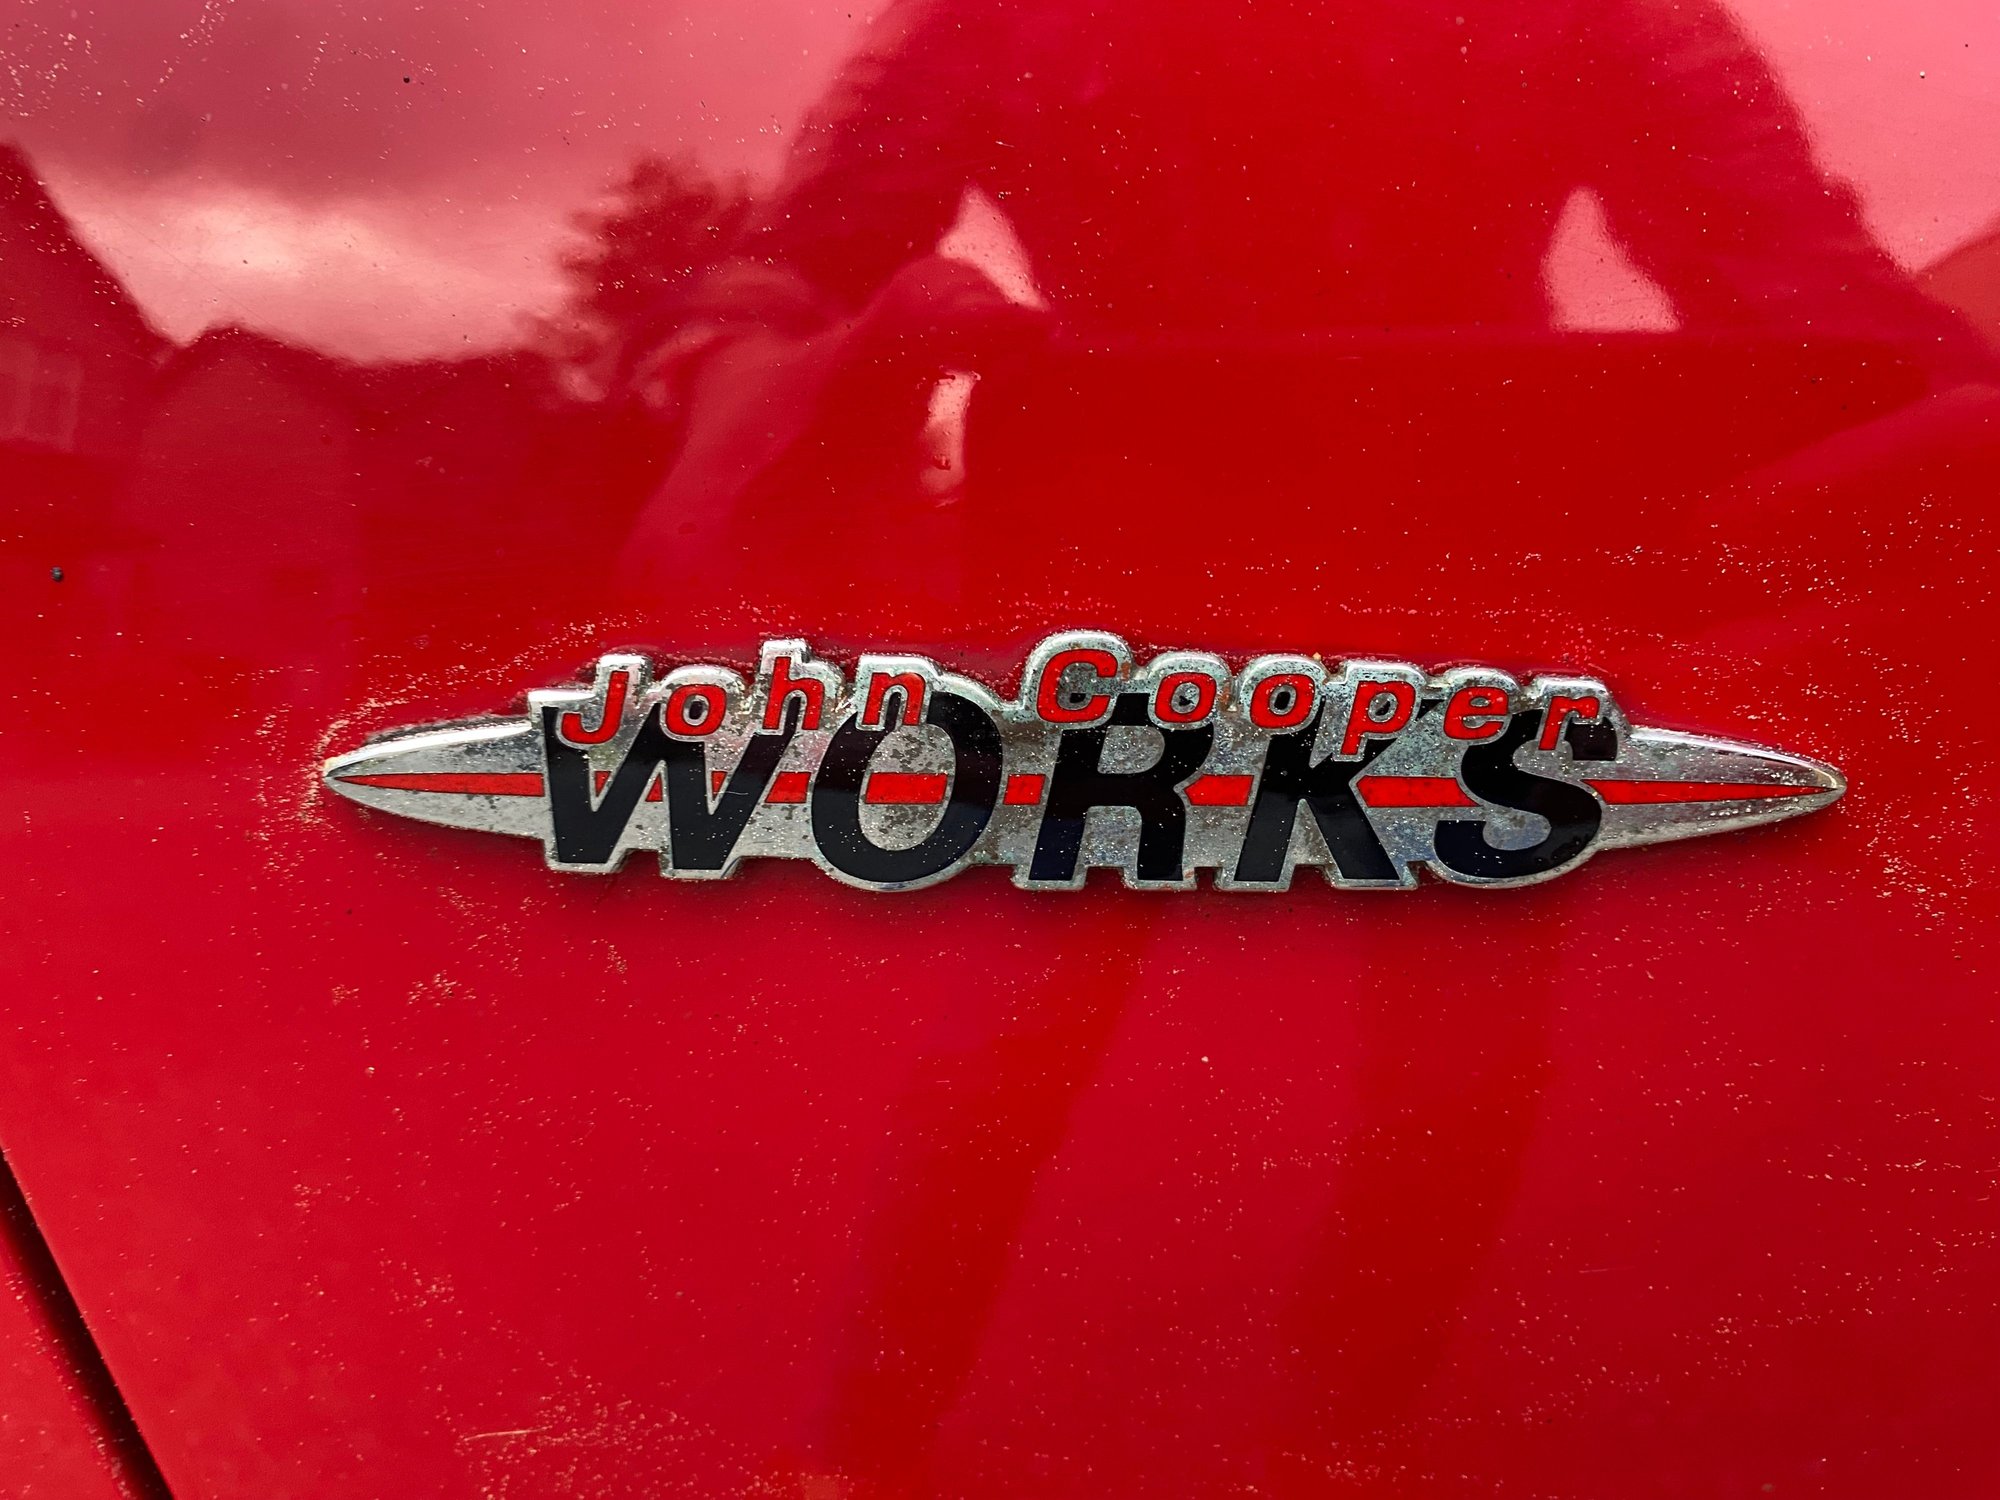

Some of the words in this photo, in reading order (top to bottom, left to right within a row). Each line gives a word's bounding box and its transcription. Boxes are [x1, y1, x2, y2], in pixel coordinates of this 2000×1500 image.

[560, 656, 928, 745] John
[1036, 649, 1600, 756] Cooper
[541, 691, 1618, 883] WORKS
